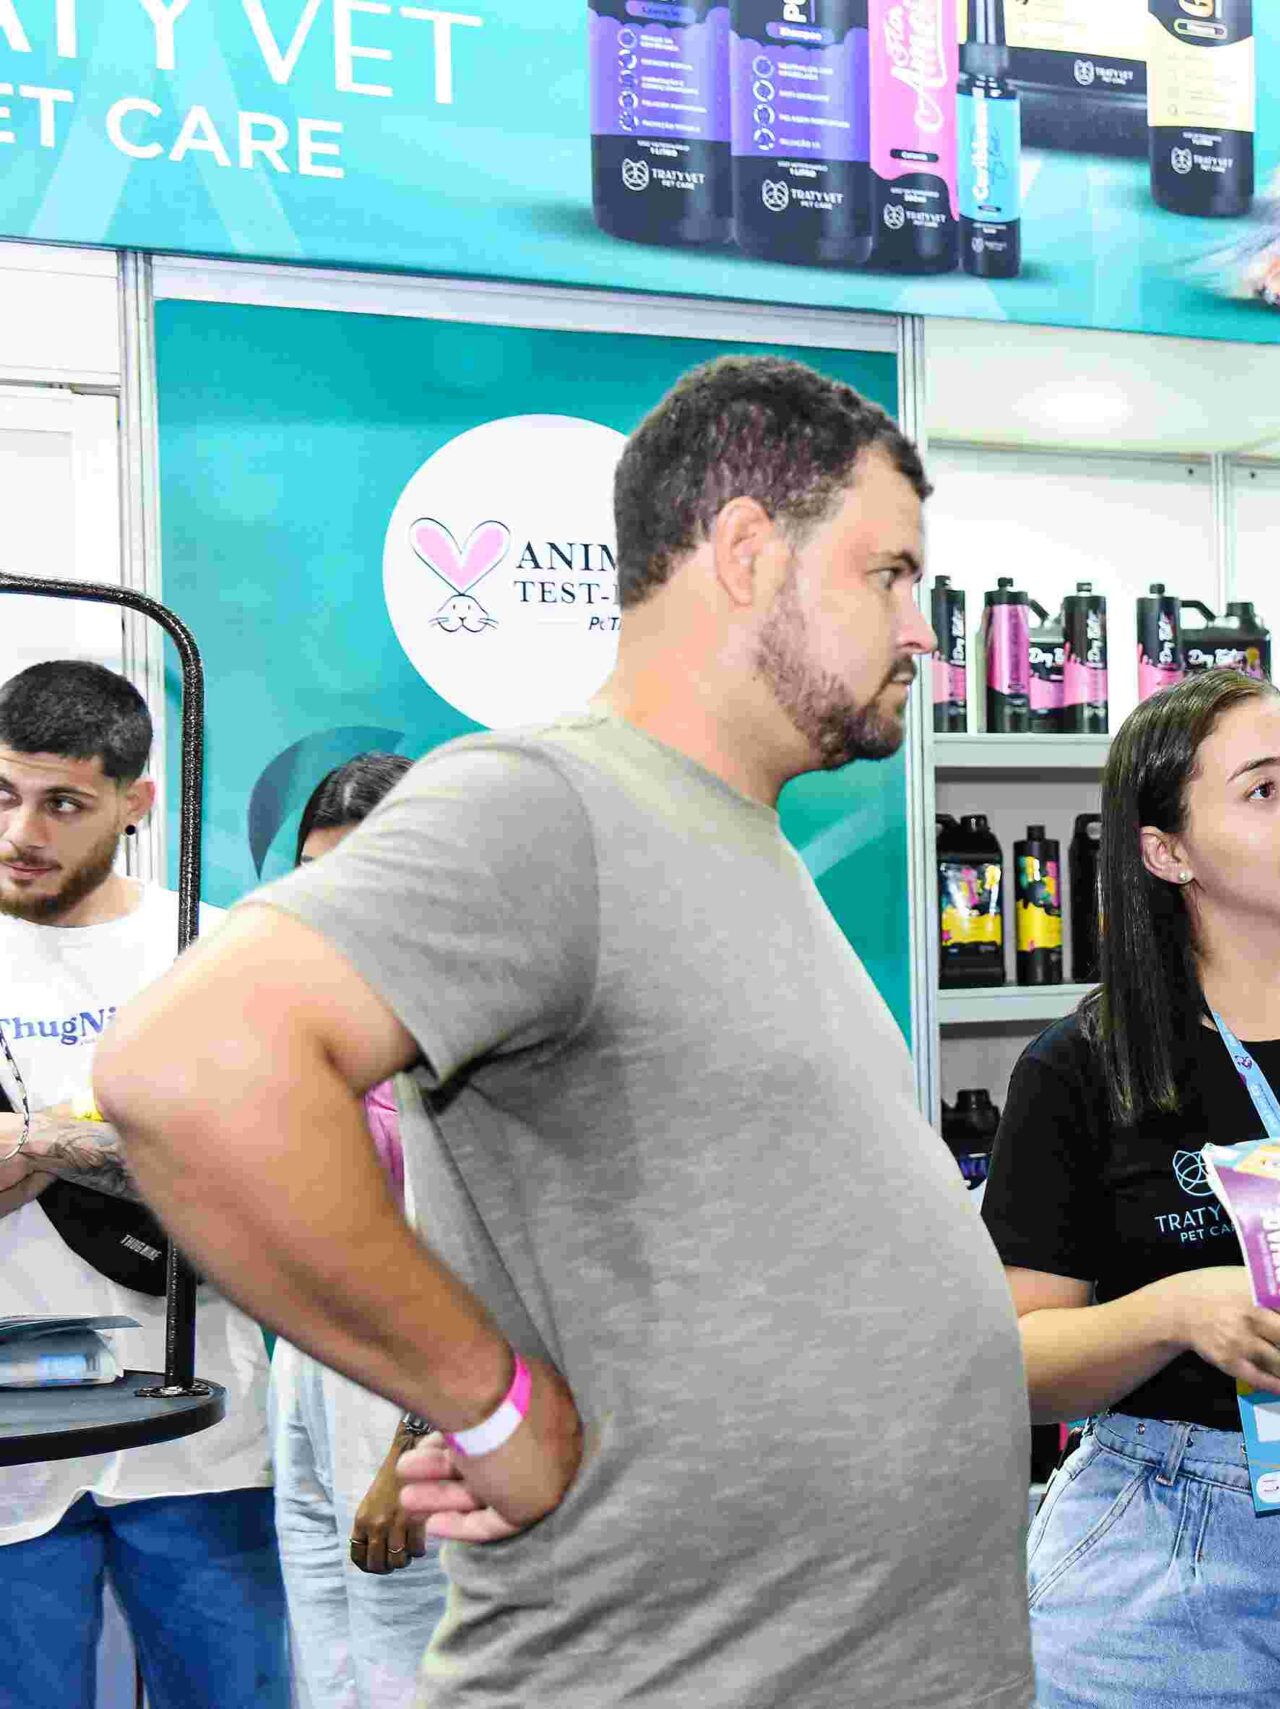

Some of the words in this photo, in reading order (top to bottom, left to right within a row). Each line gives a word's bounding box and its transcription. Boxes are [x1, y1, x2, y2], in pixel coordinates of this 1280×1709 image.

[242, 0, 483, 105] VET
[105, 96, 345, 180] CARE
[0, 1006, 117, 1046] hugN
[1154, 1203, 1220, 1232] TRATY
[1180, 1228, 1205, 1242] PET
